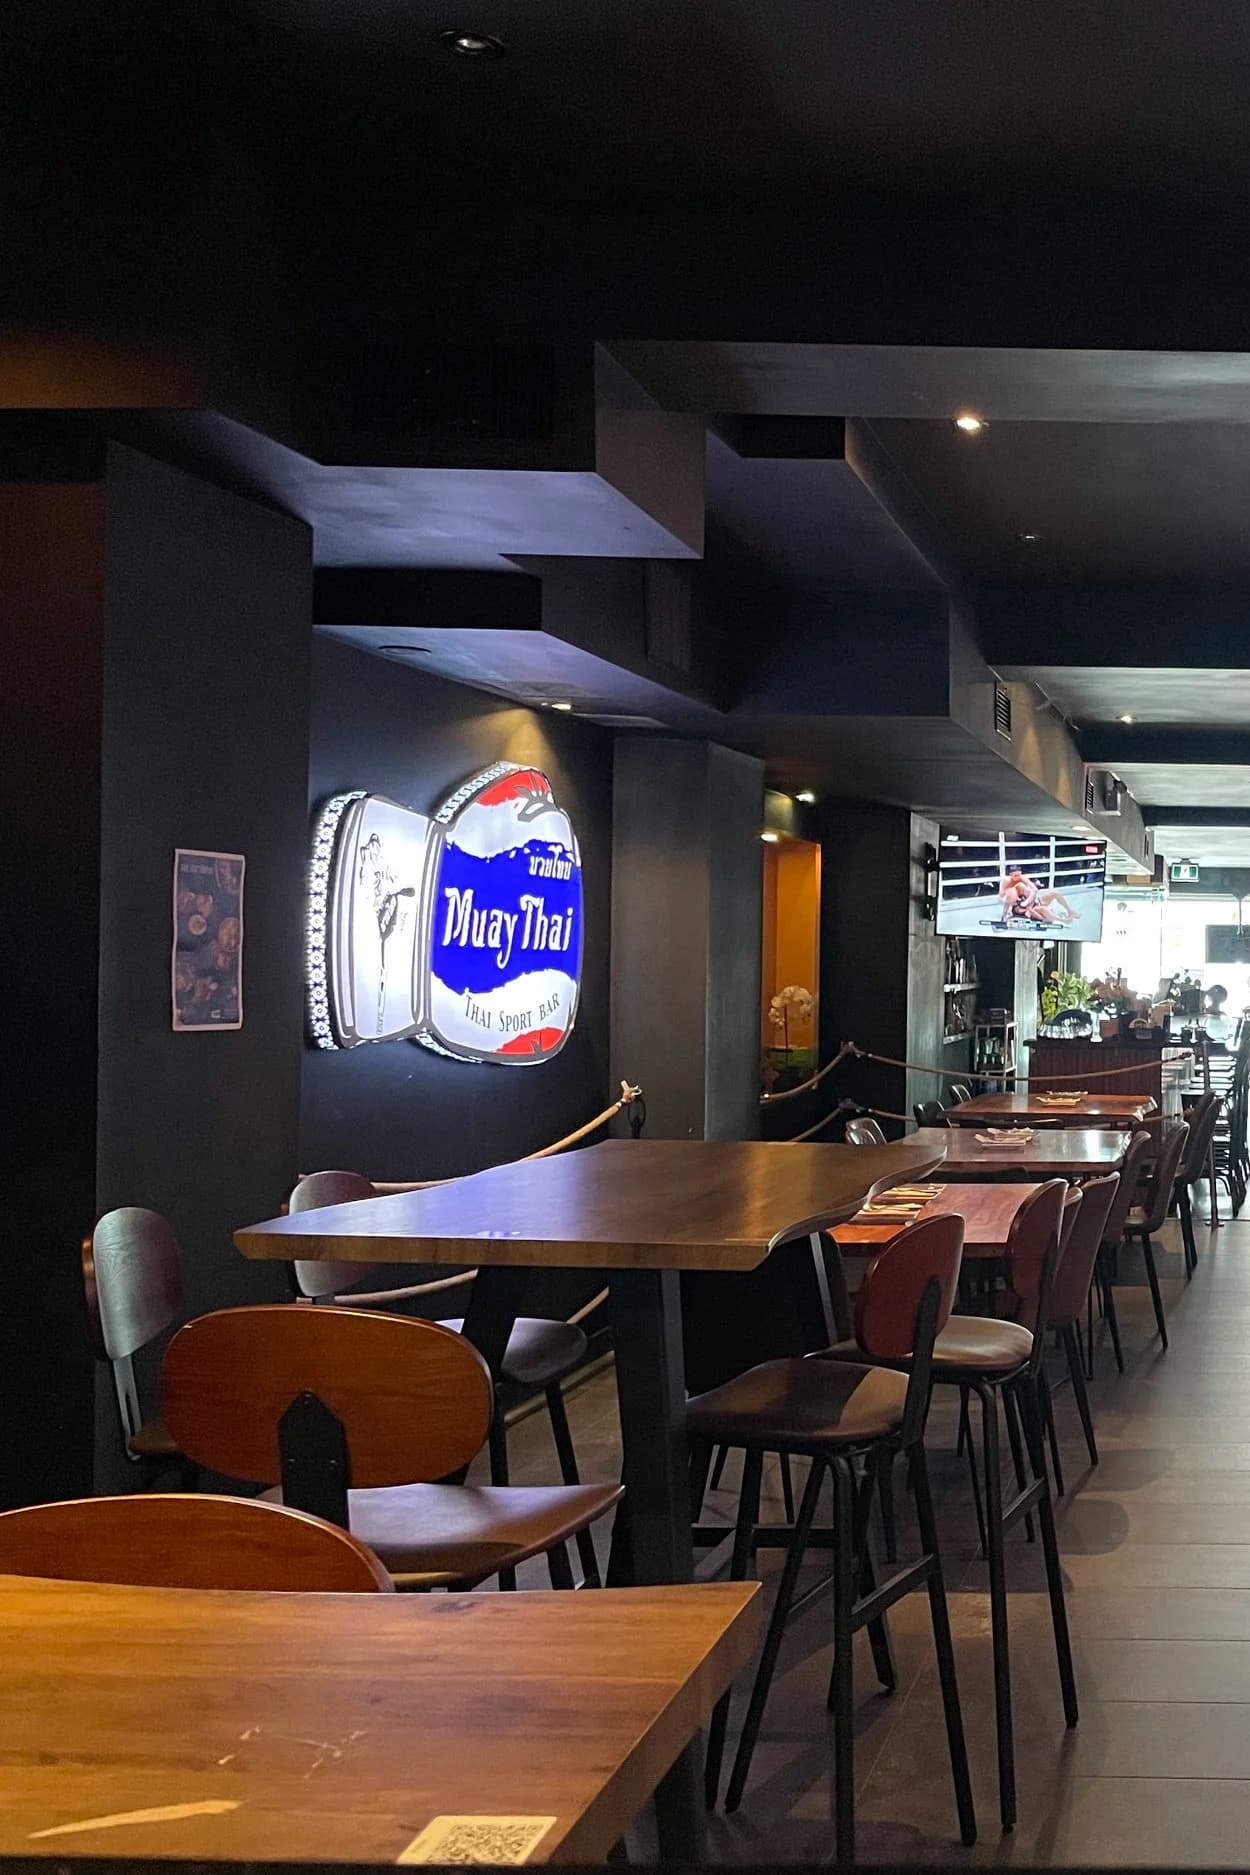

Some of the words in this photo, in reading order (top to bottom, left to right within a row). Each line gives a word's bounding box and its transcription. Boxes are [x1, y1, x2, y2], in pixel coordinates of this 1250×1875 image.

[442, 887, 518, 969] Muay
[520, 894, 573, 951] Thai
[465, 995, 491, 1029] THAI
[499, 1010, 533, 1032] SPORT
[539, 993, 560, 1021] BAR
